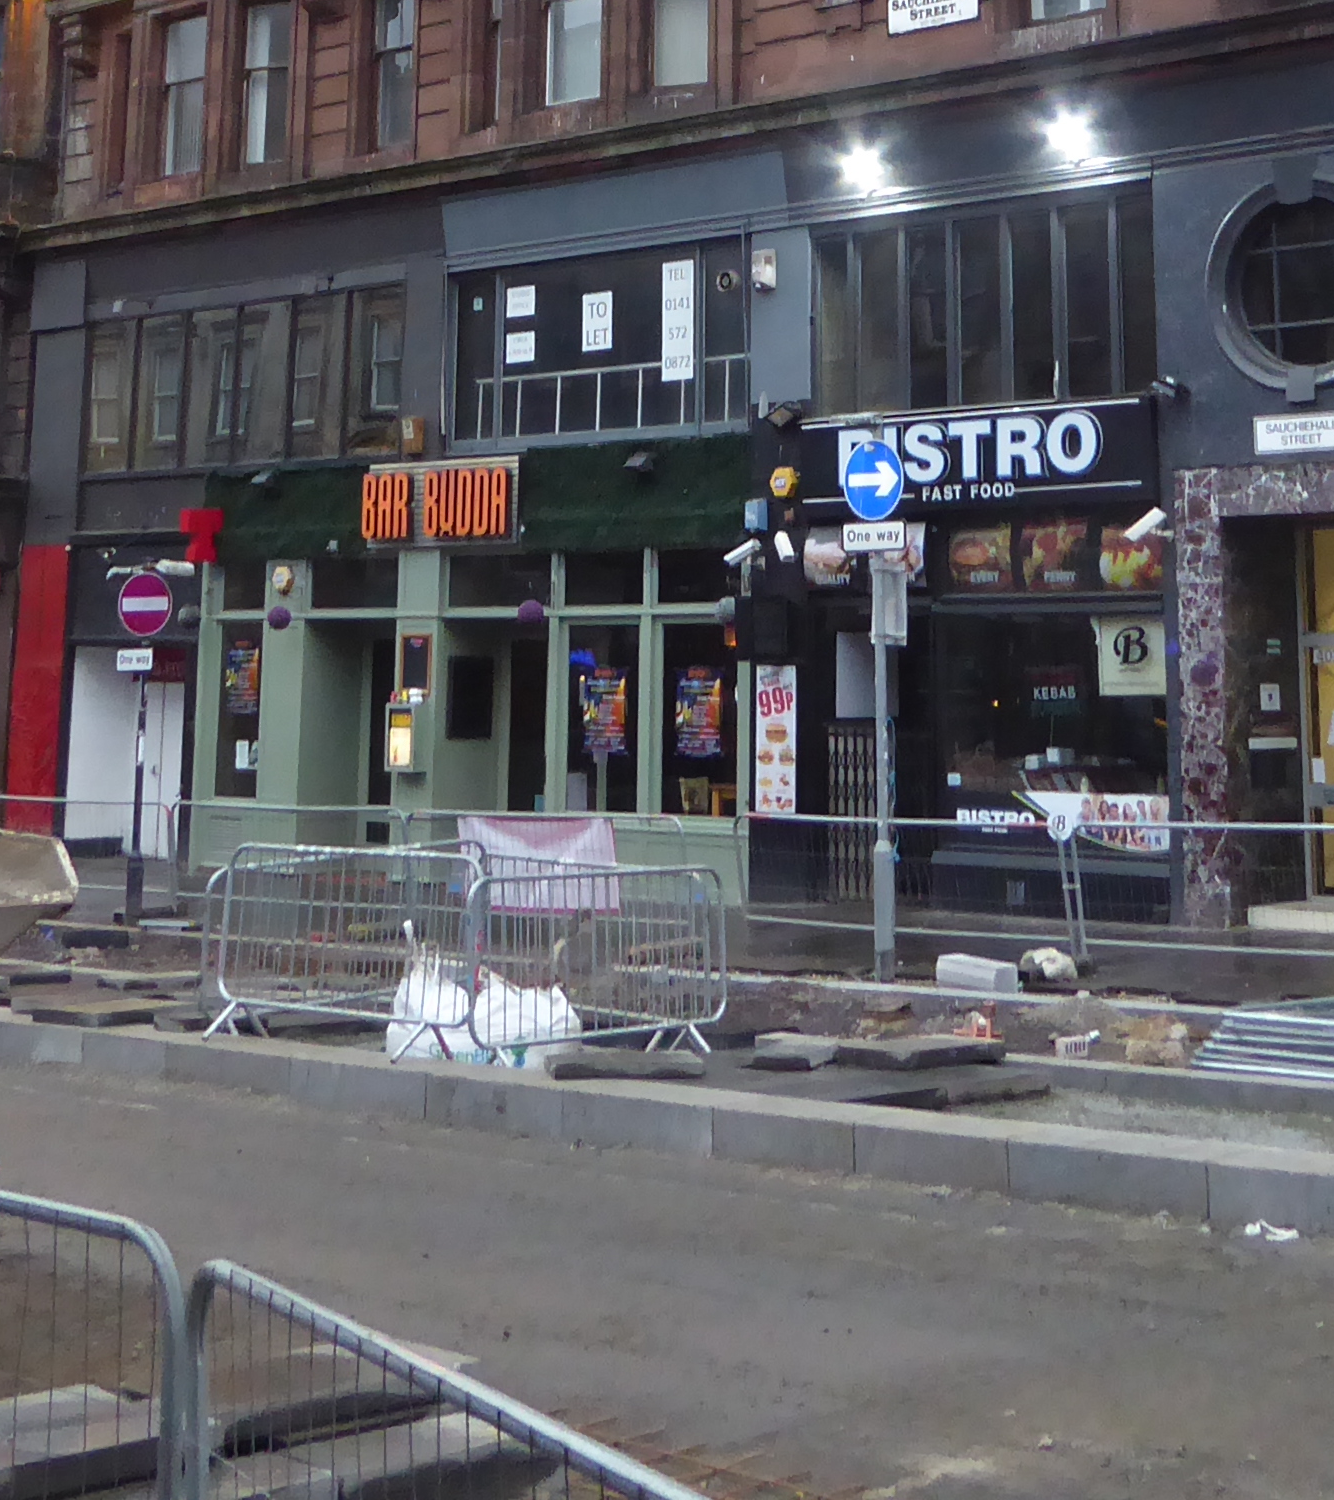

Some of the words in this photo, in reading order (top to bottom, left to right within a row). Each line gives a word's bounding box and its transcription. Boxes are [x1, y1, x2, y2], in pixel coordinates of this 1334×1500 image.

[910, 3, 956, 20] STREET
[668, 268, 685, 281] TEL
[588, 302, 607, 319] TO
[665, 297, 690, 311] 0141
[586, 328, 608, 346] LET
[668, 327, 687, 340] 572
[664, 355, 690, 370] 0872
[1281, 434, 1321, 446] STREET
[922, 485, 962, 501] FAST
[971, 482, 1015, 499] FOOD
[362, 472, 408, 539] BAR
[423, 466, 507, 537] BUDDA
[847, 529, 870, 542] One
[876, 530, 900, 543] way
[1113, 626, 1148, 665] B
[1033, 685, 1076, 700] KEBAB
[956, 808, 1037, 826] BISTRO
